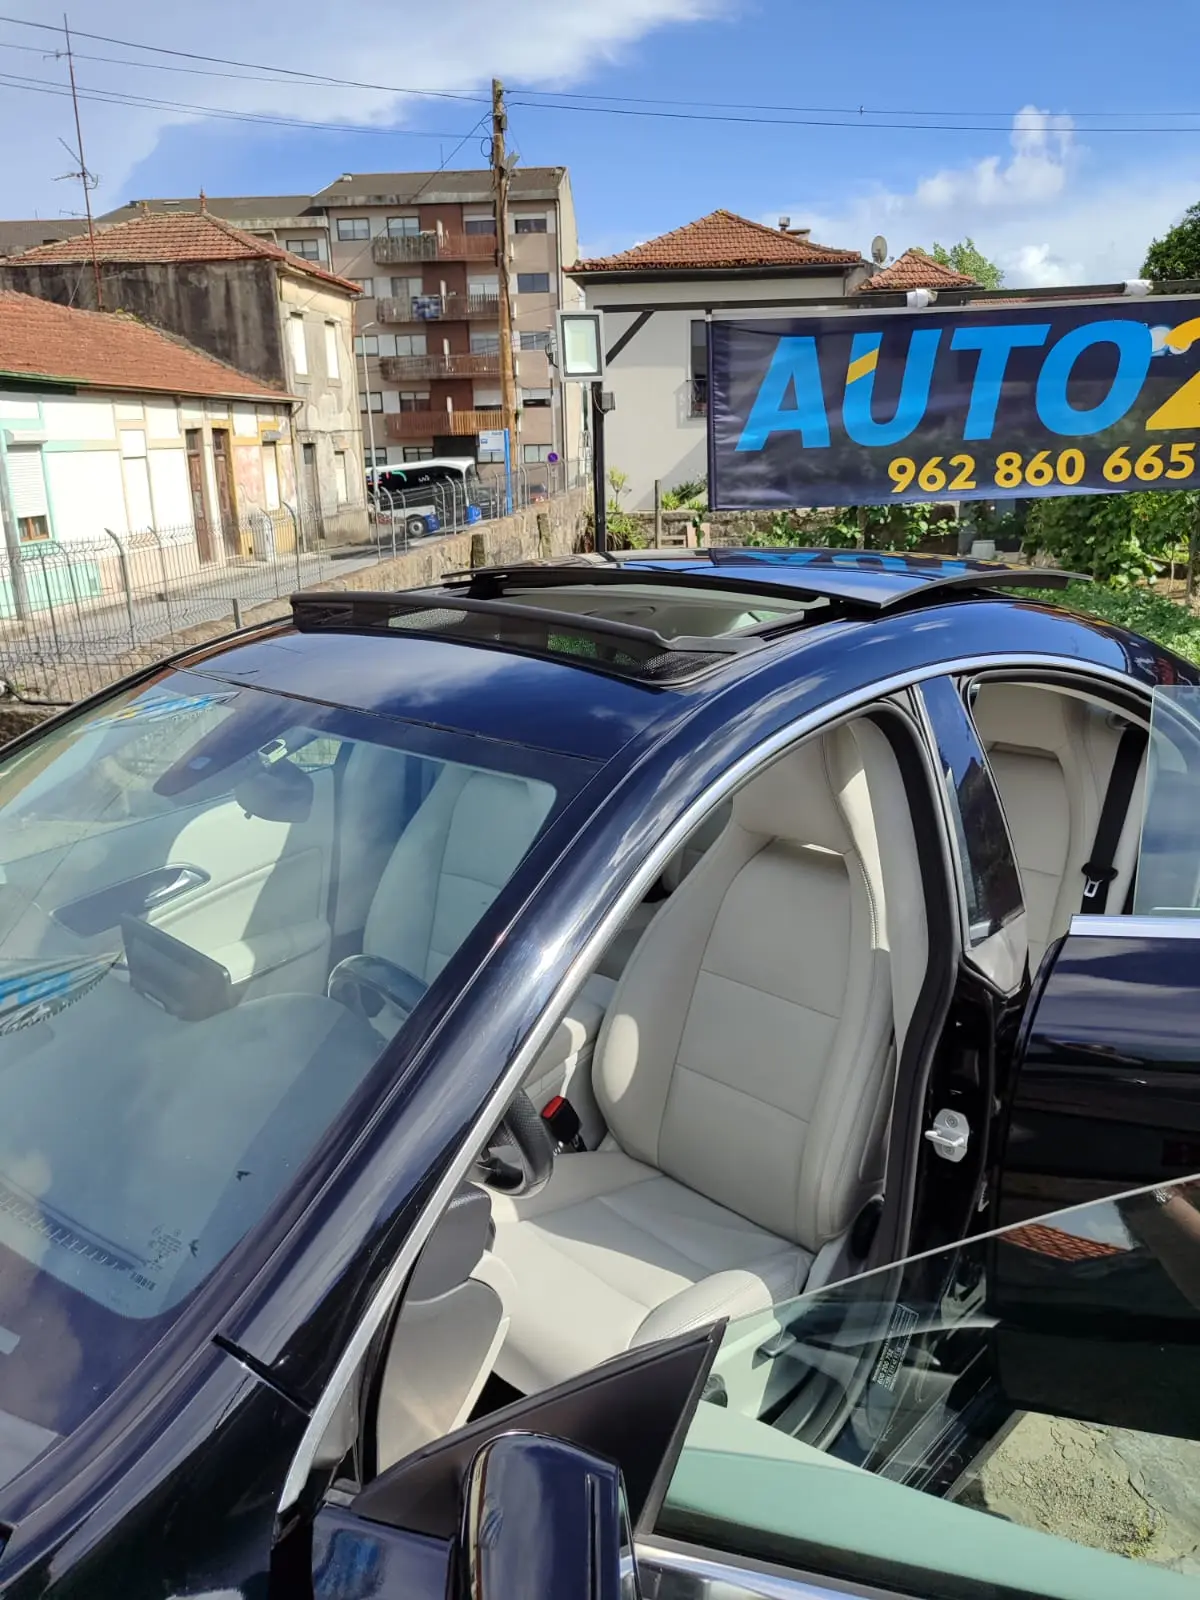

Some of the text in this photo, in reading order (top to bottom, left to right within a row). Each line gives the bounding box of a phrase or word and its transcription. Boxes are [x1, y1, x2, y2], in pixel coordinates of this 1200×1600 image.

[888, 443, 1196, 493] 962 860 665
